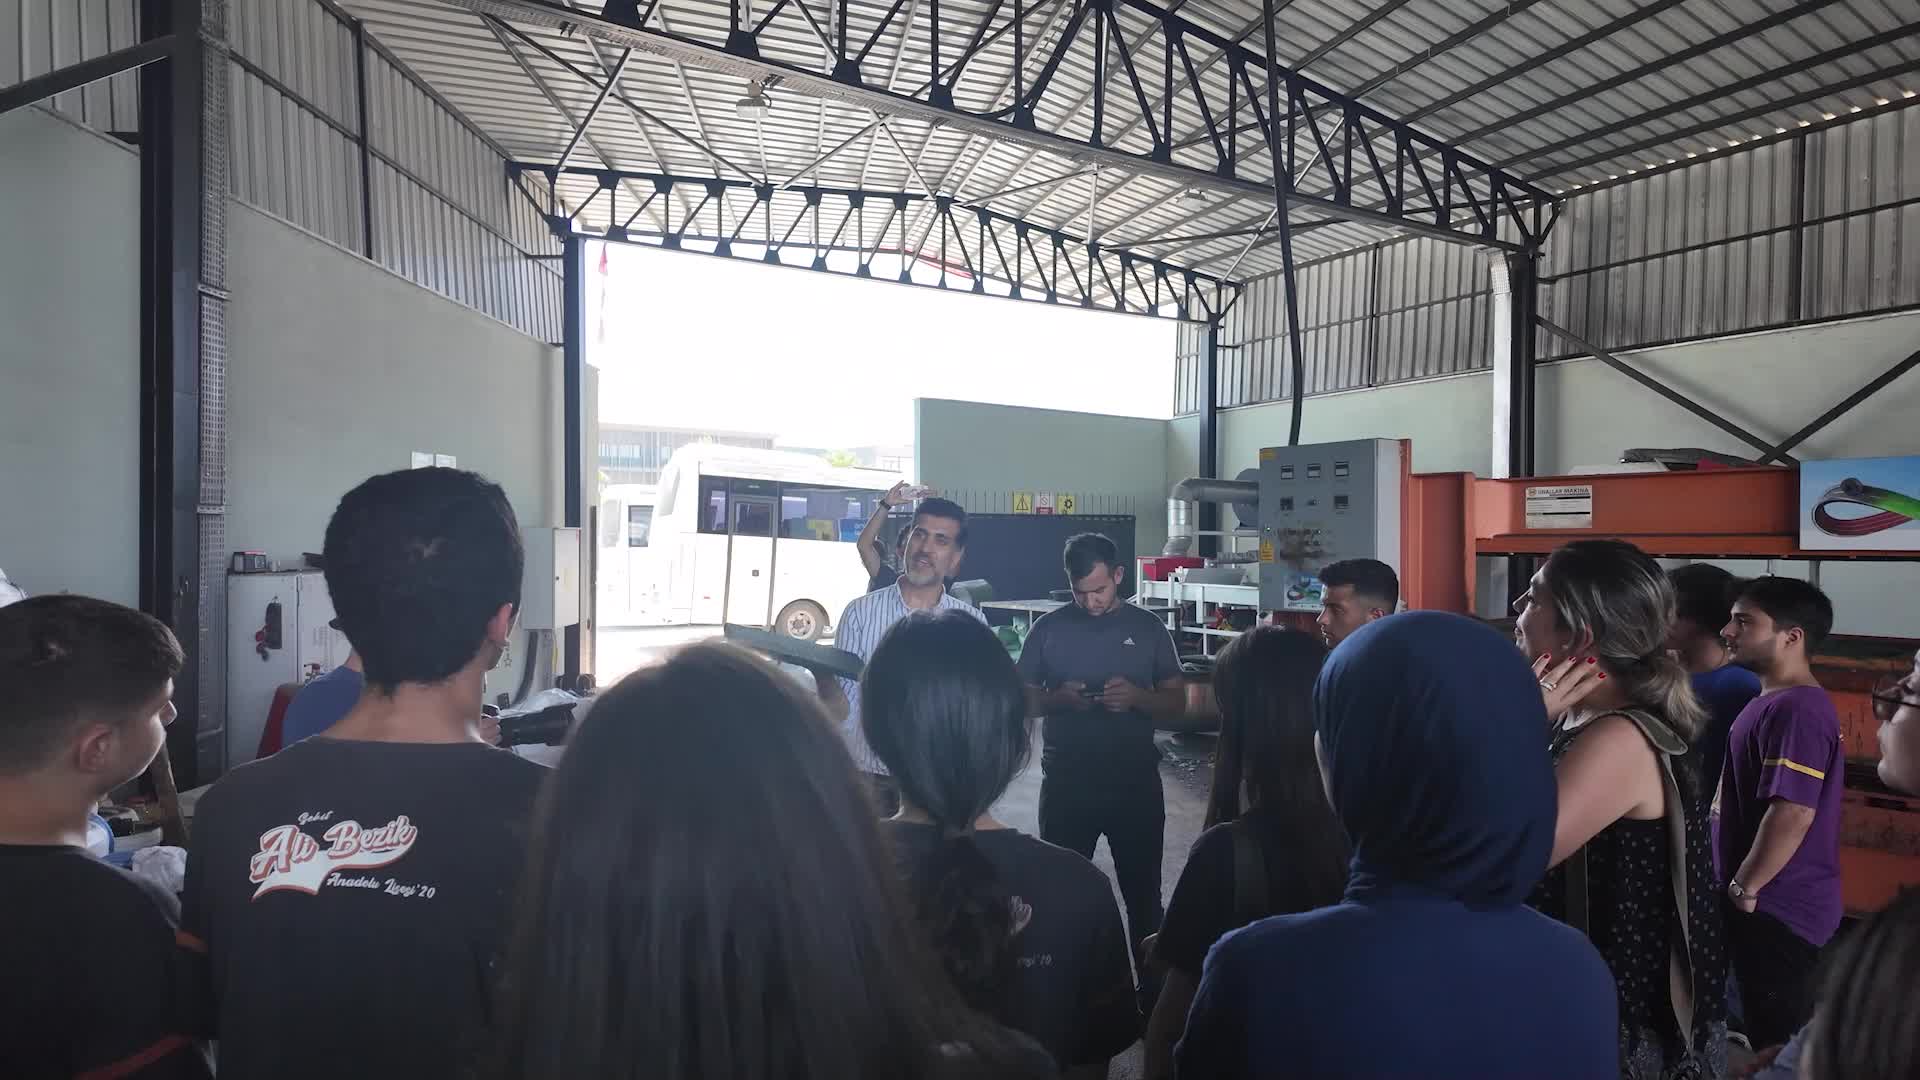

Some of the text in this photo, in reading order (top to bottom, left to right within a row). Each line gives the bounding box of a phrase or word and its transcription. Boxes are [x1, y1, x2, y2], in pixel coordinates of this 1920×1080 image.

[249, 815, 418, 884] Ali Bezik
[327, 872, 381, 889] Anadolu
